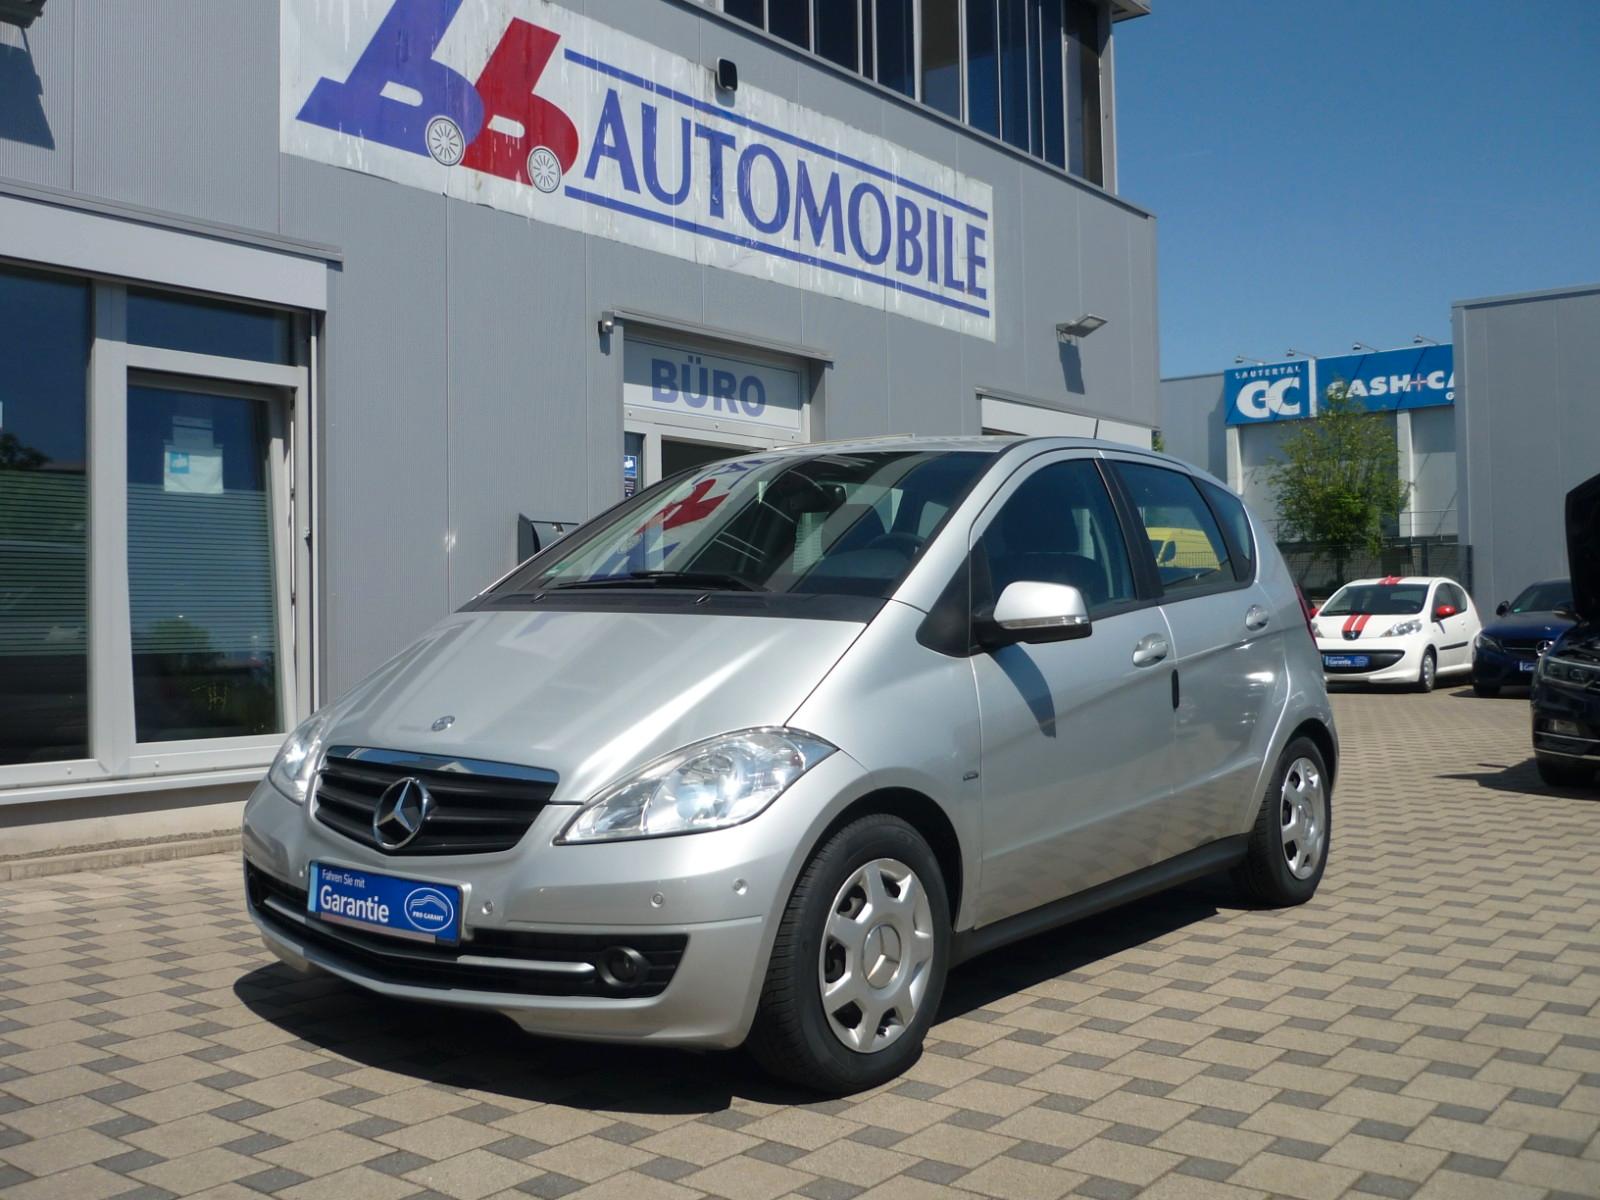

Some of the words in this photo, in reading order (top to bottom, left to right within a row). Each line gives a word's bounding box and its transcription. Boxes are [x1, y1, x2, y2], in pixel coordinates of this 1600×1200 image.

[584, 88, 988, 299] AUTOMOBILE
[651, 355, 767, 417] BÜRO
[1235, 365, 1301, 379] LAUTERTAL
[322, 868, 343, 883] Fahren
[343, 873, 353, 886] Sie
[354, 877, 366, 888] mit
[320, 884, 390, 923] Garantie
[423, 912, 444, 922] GARANT
